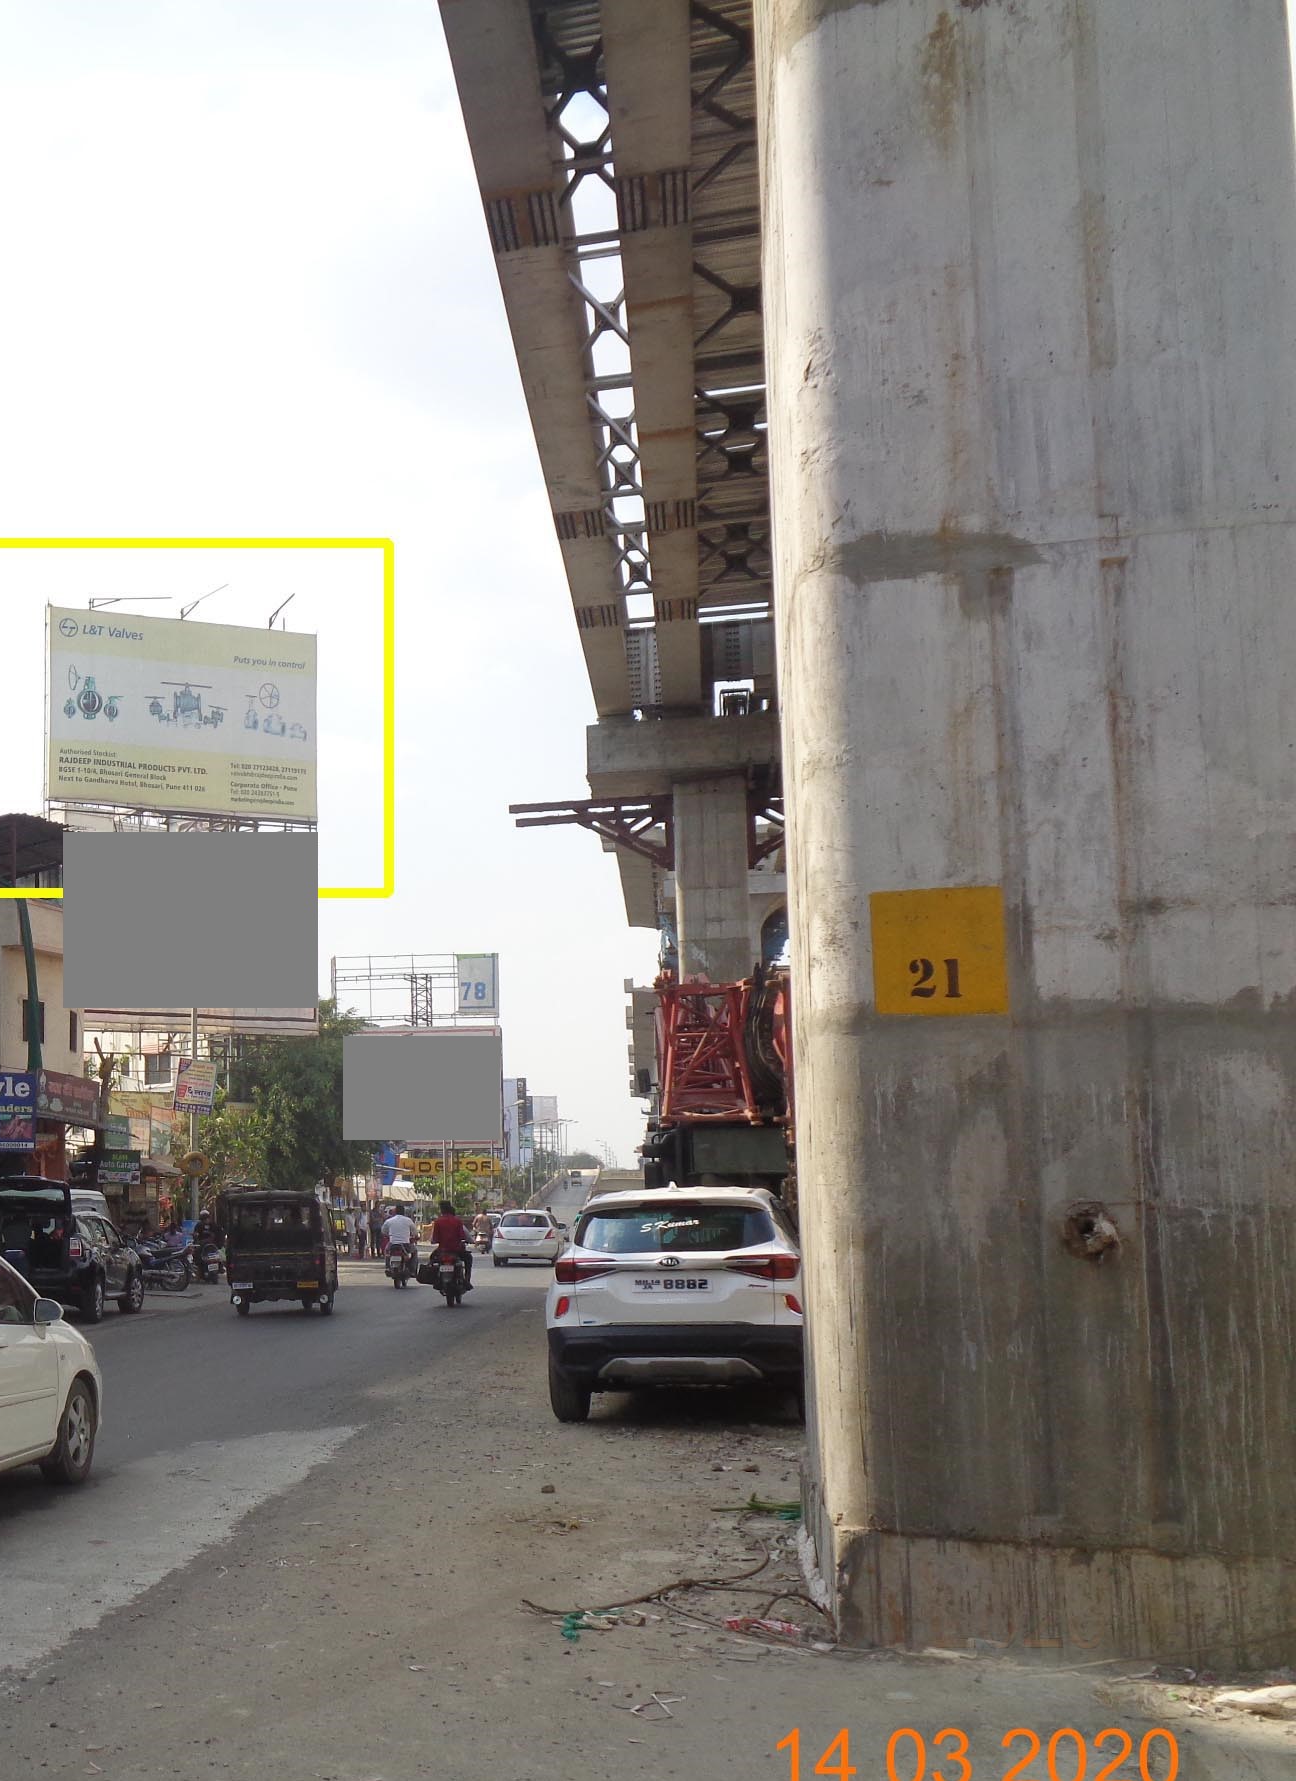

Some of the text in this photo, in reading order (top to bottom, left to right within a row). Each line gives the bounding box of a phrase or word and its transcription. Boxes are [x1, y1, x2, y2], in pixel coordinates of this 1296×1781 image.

[82, 624, 144, 641] L&T Valves
[233, 655, 306, 670] Puts you in control
[58, 756, 208, 775] RAJDEEP INDUSTRIAL PRODUCTS PVT. LTD.
[58, 774, 74, 782] Next
[75, 775, 83, 783] to
[84, 776, 119, 785] Gandharva
[165, 783, 181, 791] Pune
[124, 771, 149, 780] General
[908, 958, 963, 998] 21
[460, 981, 487, 1001] 78
[661, 1257, 679, 1267] KIA
